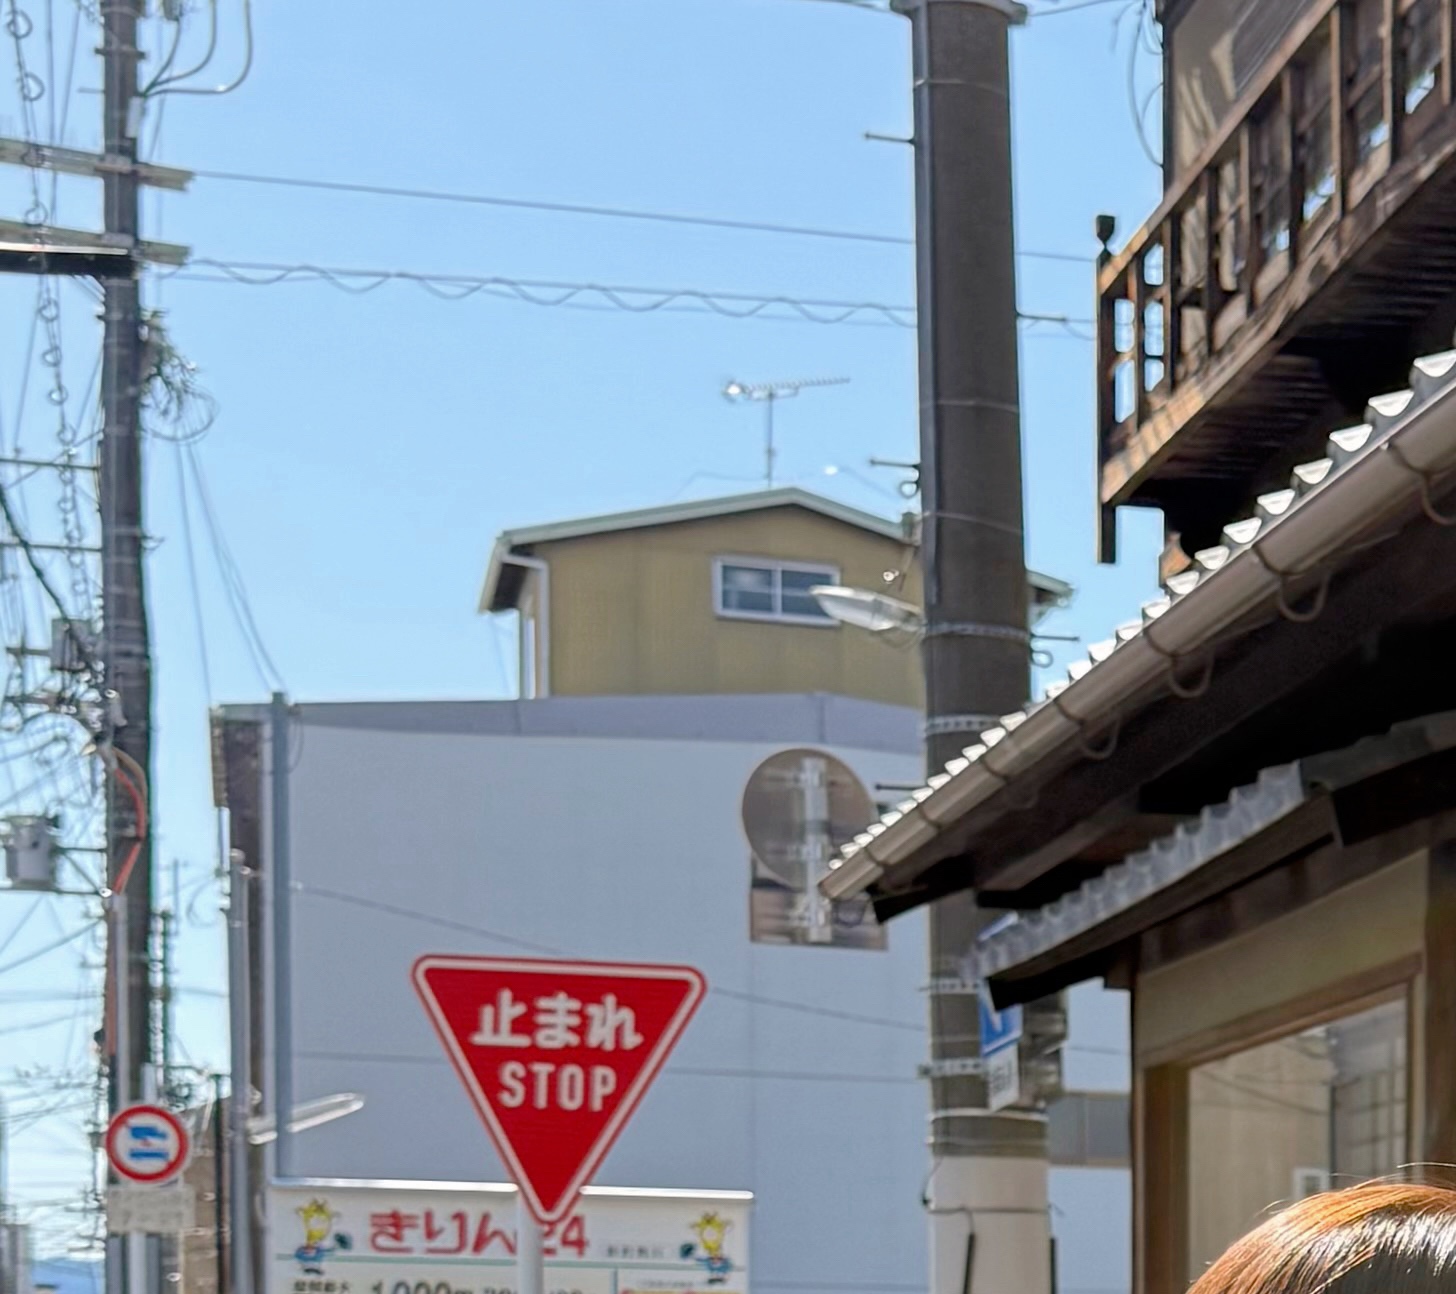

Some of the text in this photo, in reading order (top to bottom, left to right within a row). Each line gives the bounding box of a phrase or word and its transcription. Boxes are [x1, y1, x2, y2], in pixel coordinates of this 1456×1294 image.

[469, 987, 645, 1052] 止まれ
[498, 1060, 618, 1112] STOP
